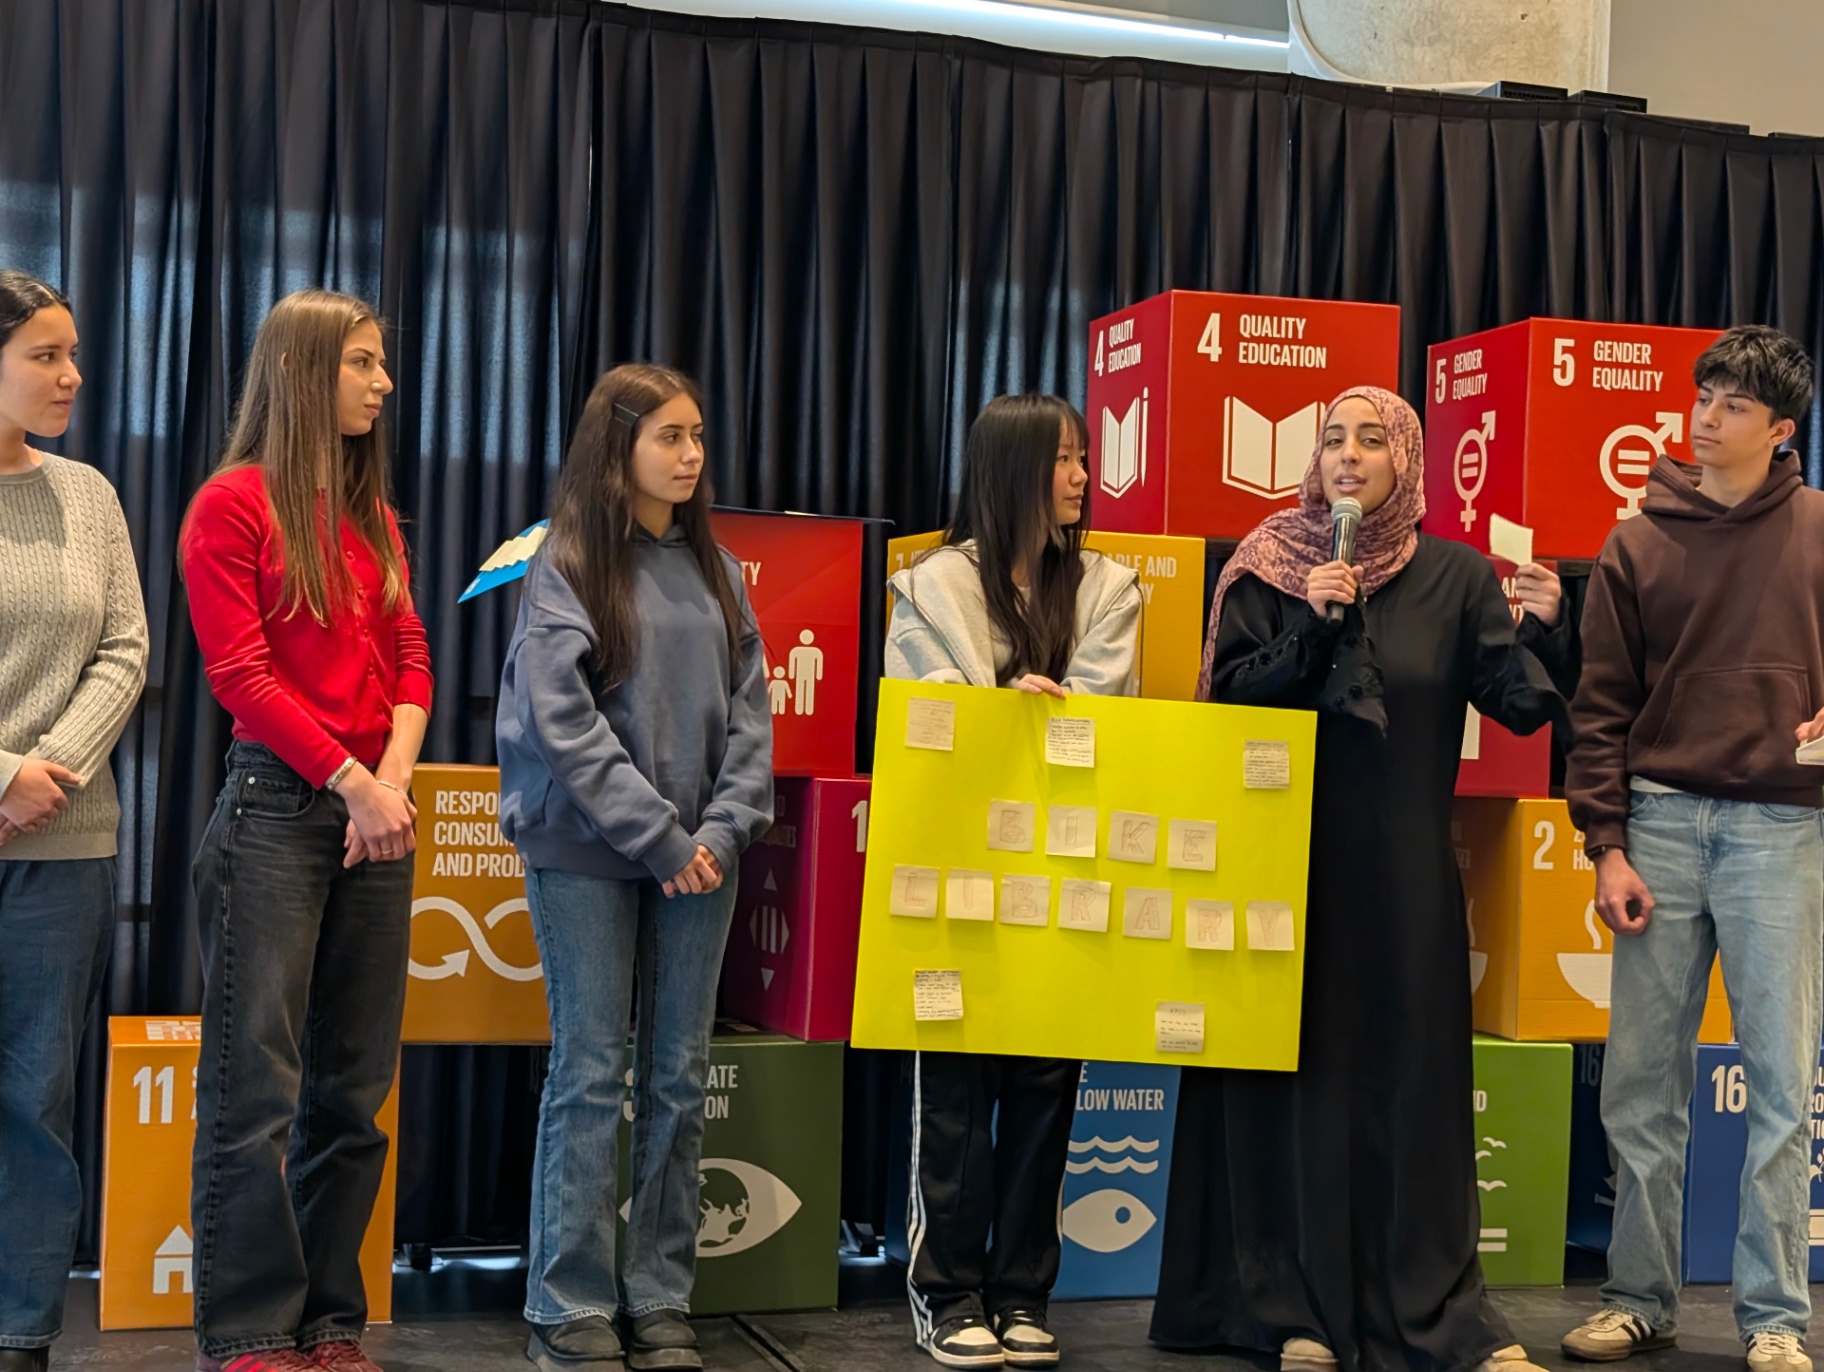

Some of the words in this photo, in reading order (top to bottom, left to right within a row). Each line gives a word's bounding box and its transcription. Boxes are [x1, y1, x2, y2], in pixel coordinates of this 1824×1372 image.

[1108, 318, 1134, 348] QUALITY
[1197, 312, 1222, 362] 4
[1239, 314, 1307, 340] QUALITY
[1094, 330, 1104, 377] 4
[1108, 342, 1141, 373] EDUCATION
[1238, 342, 1327, 369] EDUCATION
[1453, 348, 1483, 374] GENDER
[1552, 337, 1575, 387] 5
[1593, 340, 1652, 365] GENDER
[1435, 358, 1447, 404] 5
[1452, 372, 1488, 400] EQUALITY
[1592, 367, 1664, 392] EQUALITY
[1145, 555, 1177, 578] AND
[435, 790, 501, 815] RESPO
[999, 809, 1206, 863] BIKE
[1533, 820, 1555, 870] 2
[432, 852, 473, 877] AND
[904, 872, 1282, 948] LIBRARY
[703, 1065, 739, 1089] ATE
[1711, 1065, 1747, 1113] 16
[132, 1066, 175, 1124] 11
[1113, 1089, 1164, 1111] WATER
